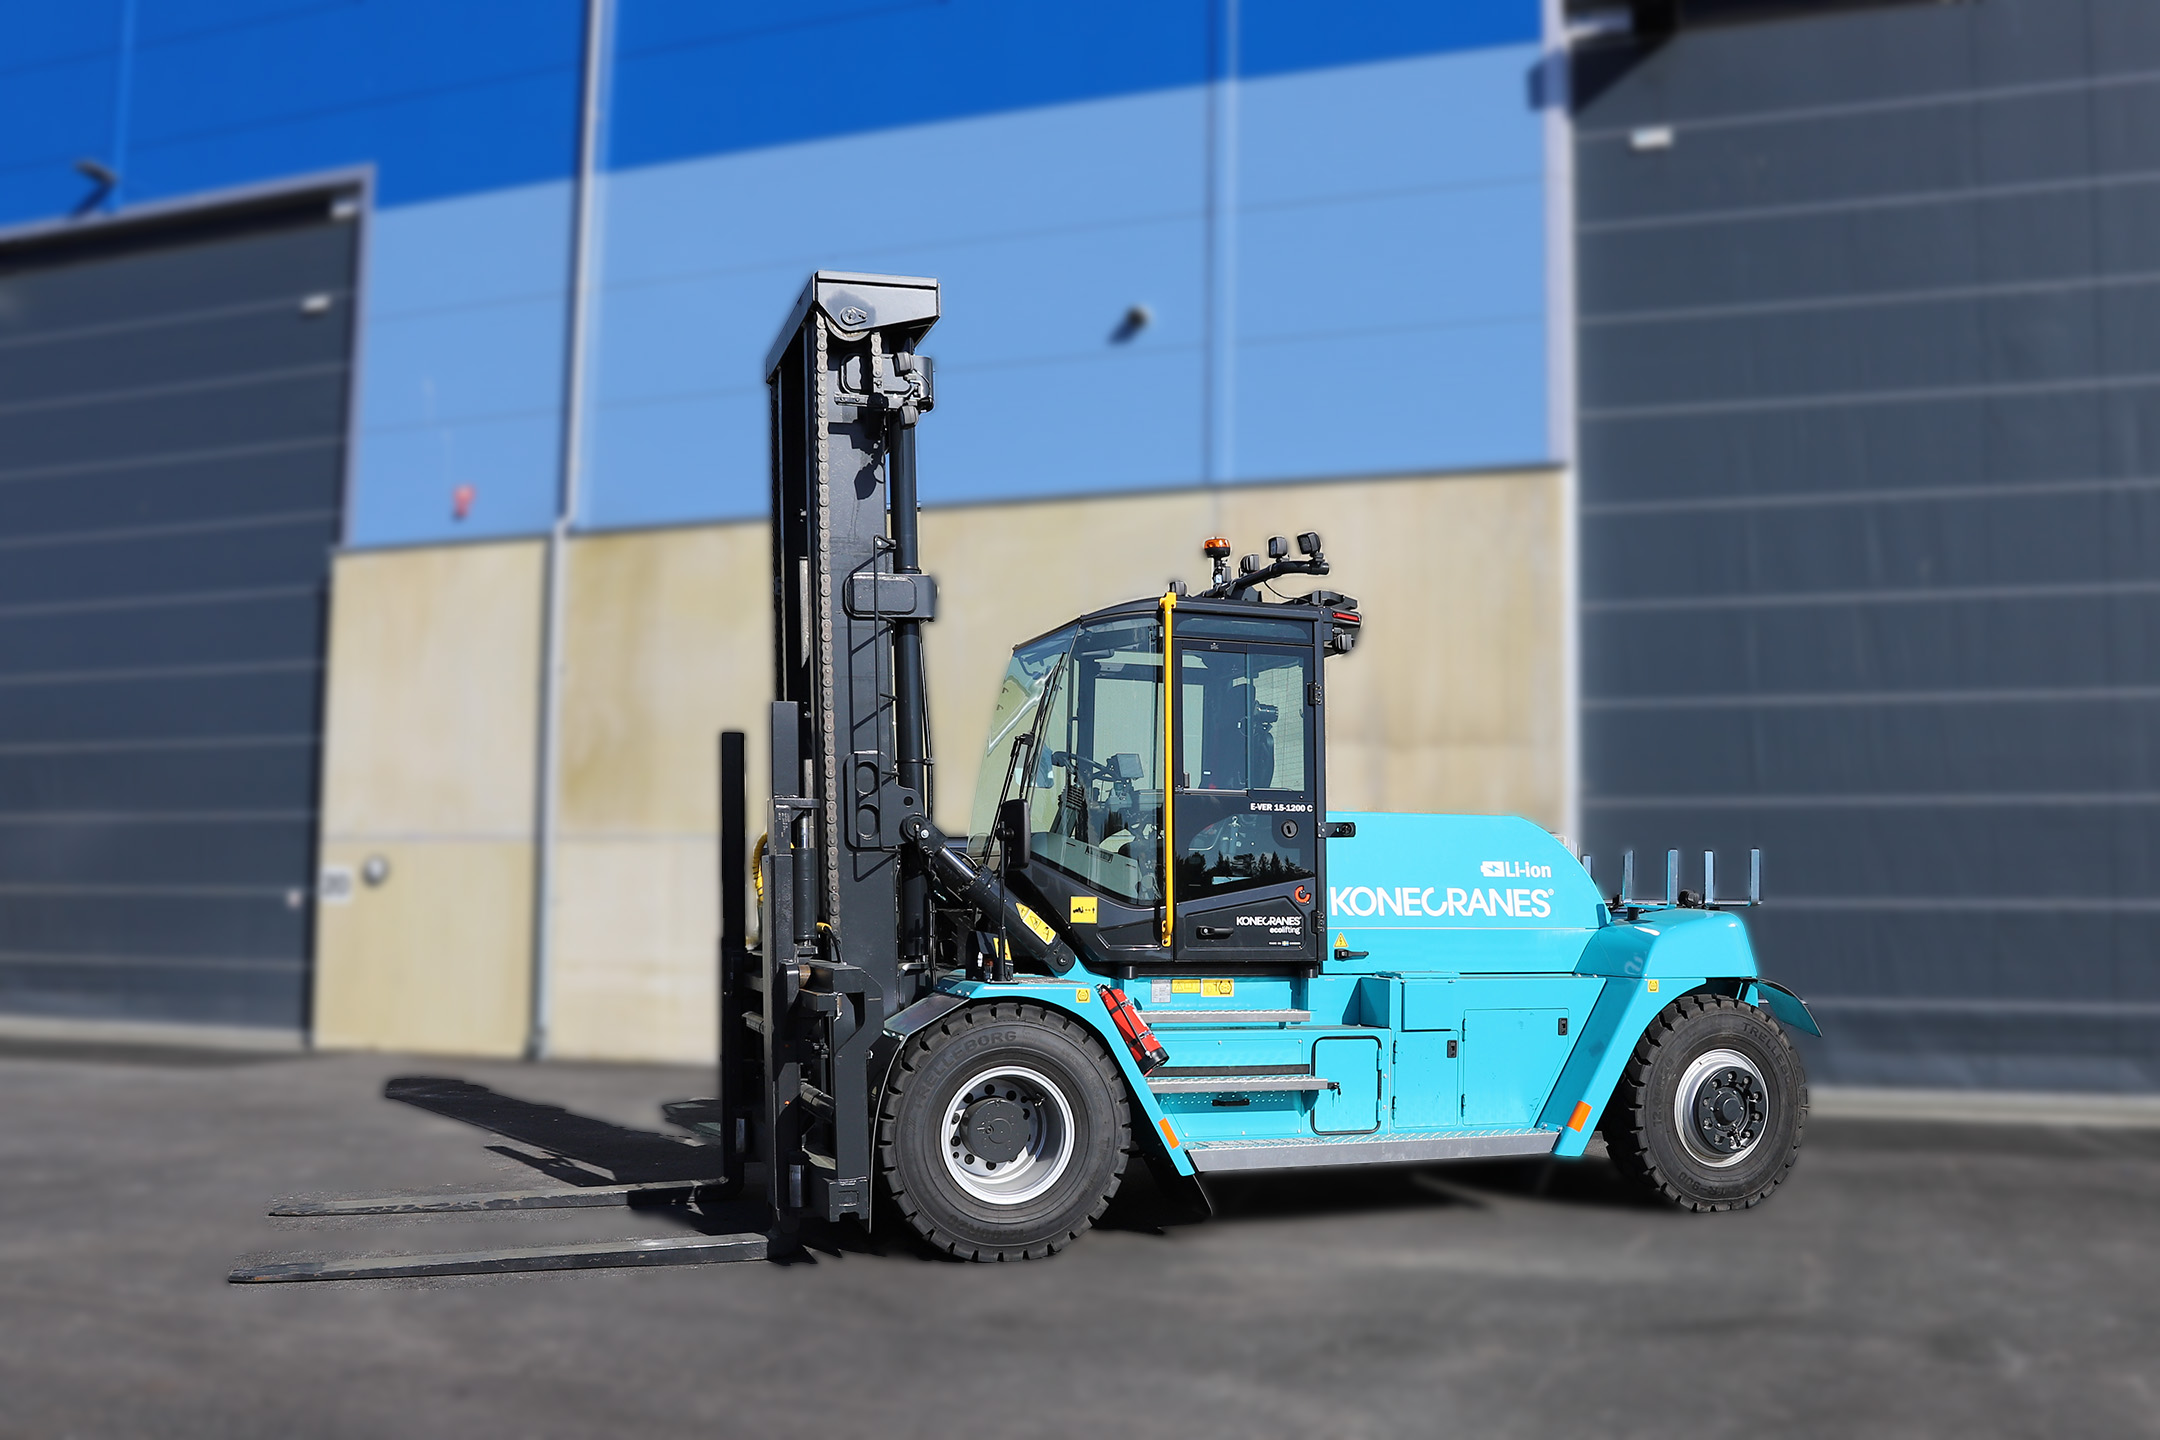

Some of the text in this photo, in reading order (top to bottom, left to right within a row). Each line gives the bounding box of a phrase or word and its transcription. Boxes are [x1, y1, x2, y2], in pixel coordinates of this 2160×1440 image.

[1250, 802, 1313, 813] E-VER 15-1200 C
[1505, 861, 1552, 878] Li-ion
[1236, 916, 1301, 926] KONECRANES
[1269, 926, 1302, 935] ecolifting
